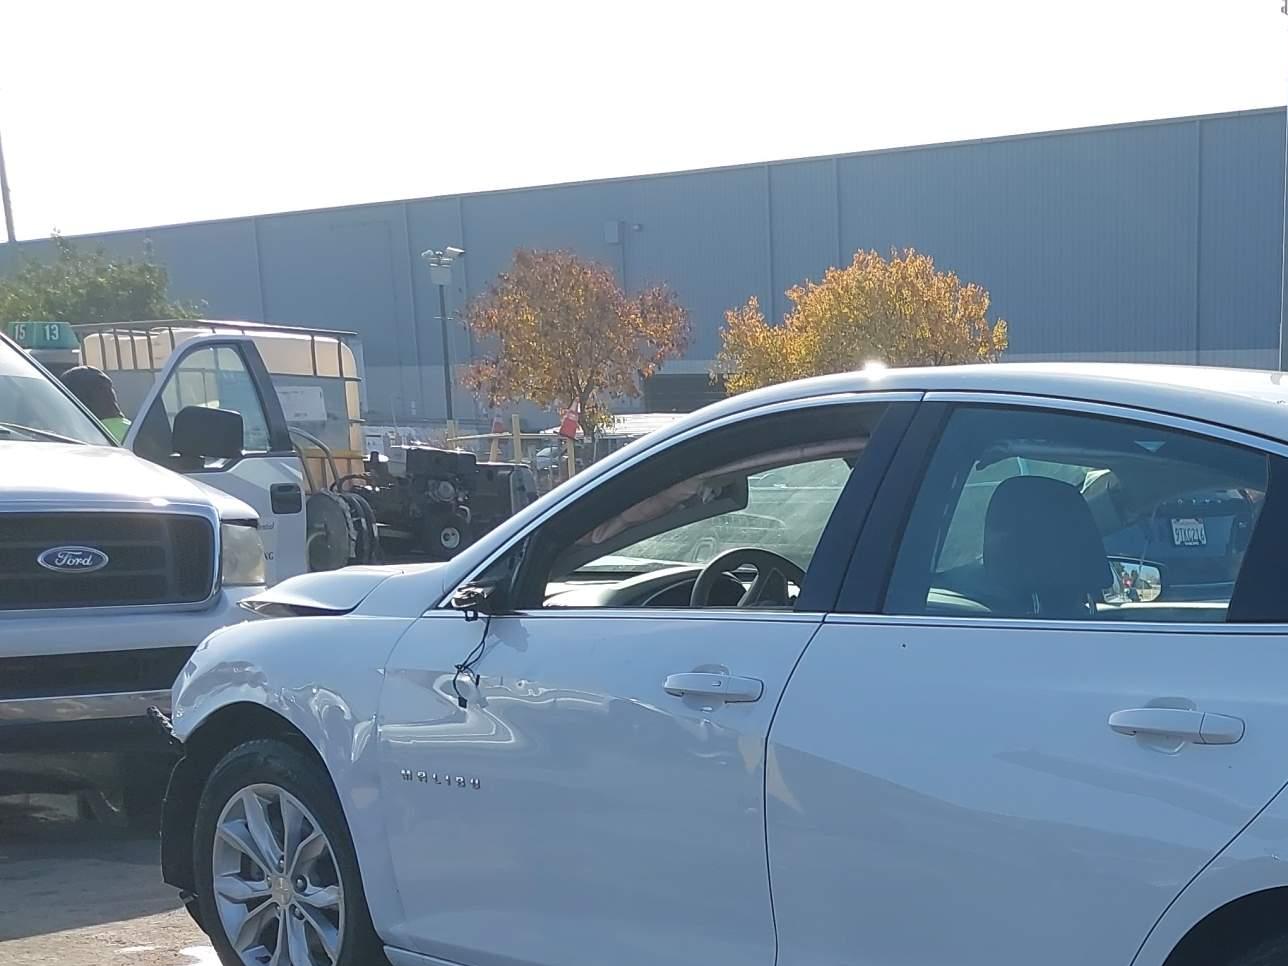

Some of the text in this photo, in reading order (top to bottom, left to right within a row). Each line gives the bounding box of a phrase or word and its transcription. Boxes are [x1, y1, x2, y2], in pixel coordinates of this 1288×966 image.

[15, 324, 26, 340] 15
[45, 324, 59, 340] 13
[55, 551, 93, 566] Ford
[400, 769, 481, 790] MALIBU
